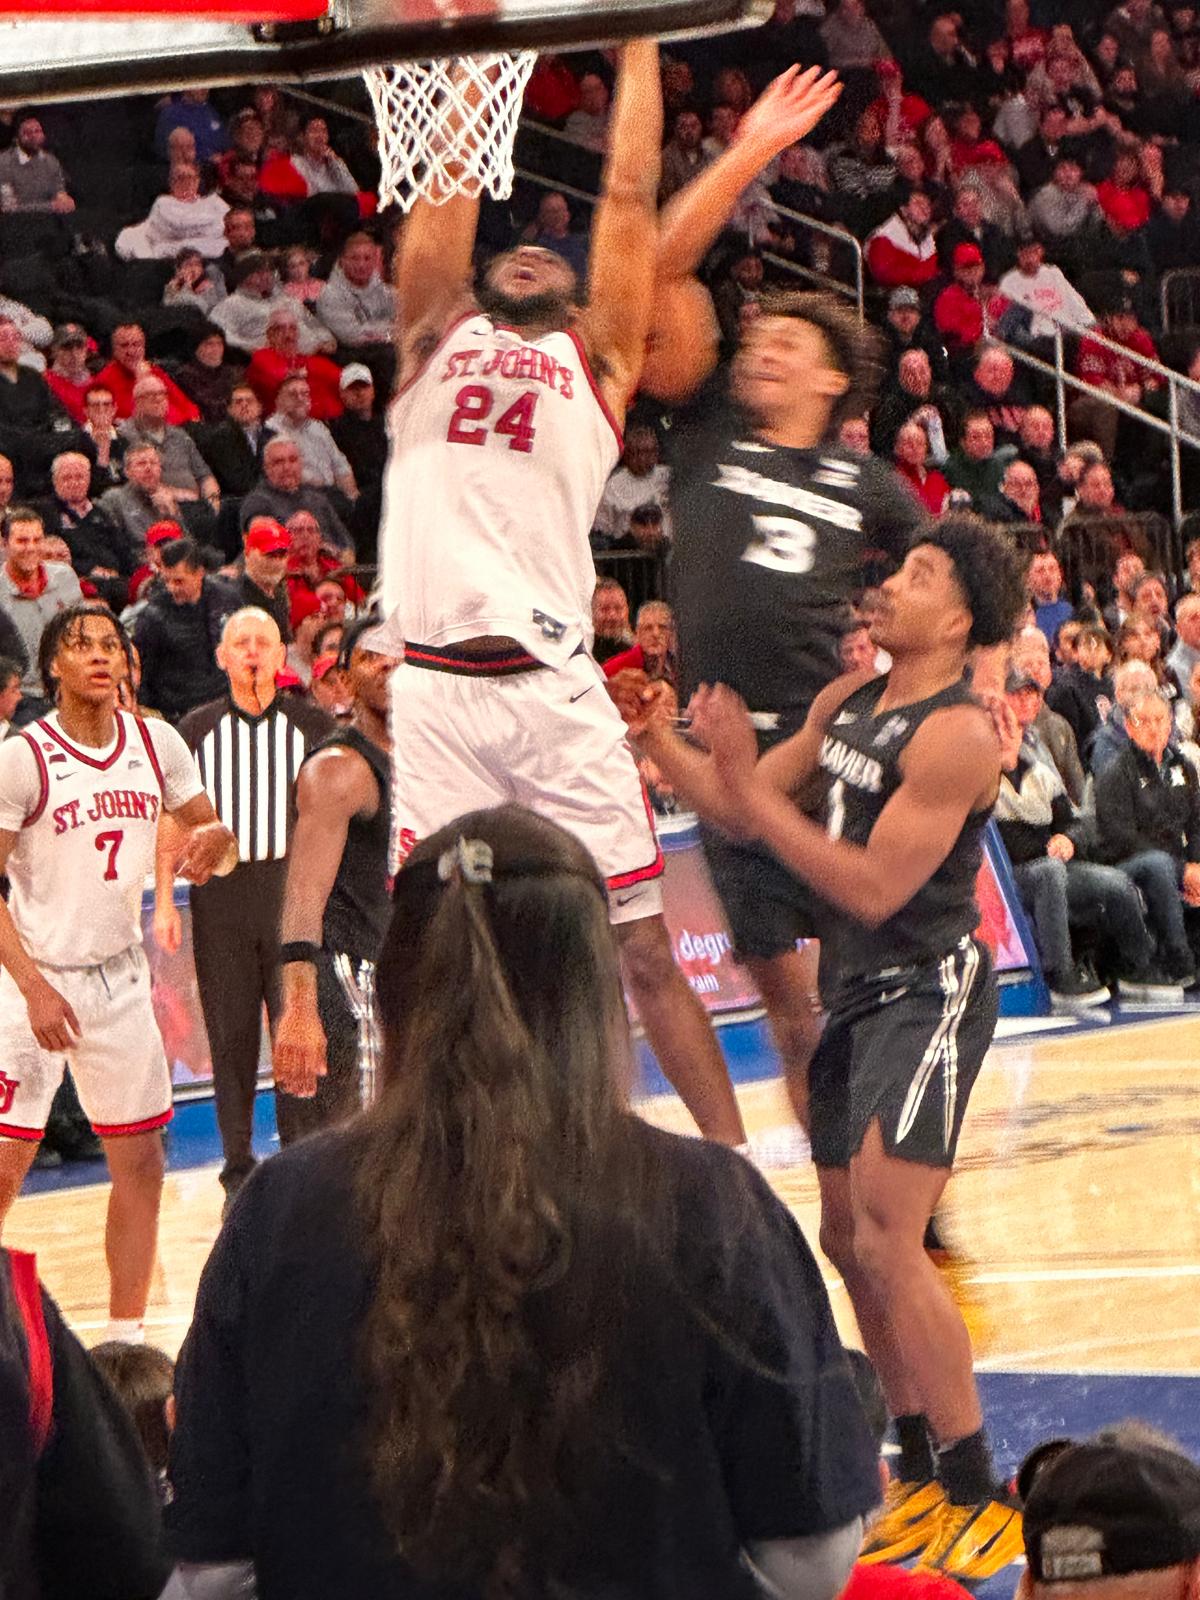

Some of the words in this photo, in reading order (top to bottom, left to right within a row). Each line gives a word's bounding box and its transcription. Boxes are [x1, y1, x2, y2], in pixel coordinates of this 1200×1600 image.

[446, 384, 539, 453] 24
[740, 514, 817, 574] 3
[819, 735, 884, 793] XAVIER
[53, 799, 85, 835] ST.
[828, 779, 846, 841] 1
[95, 830, 124, 881] 7
[680, 929, 731, 965] degr
